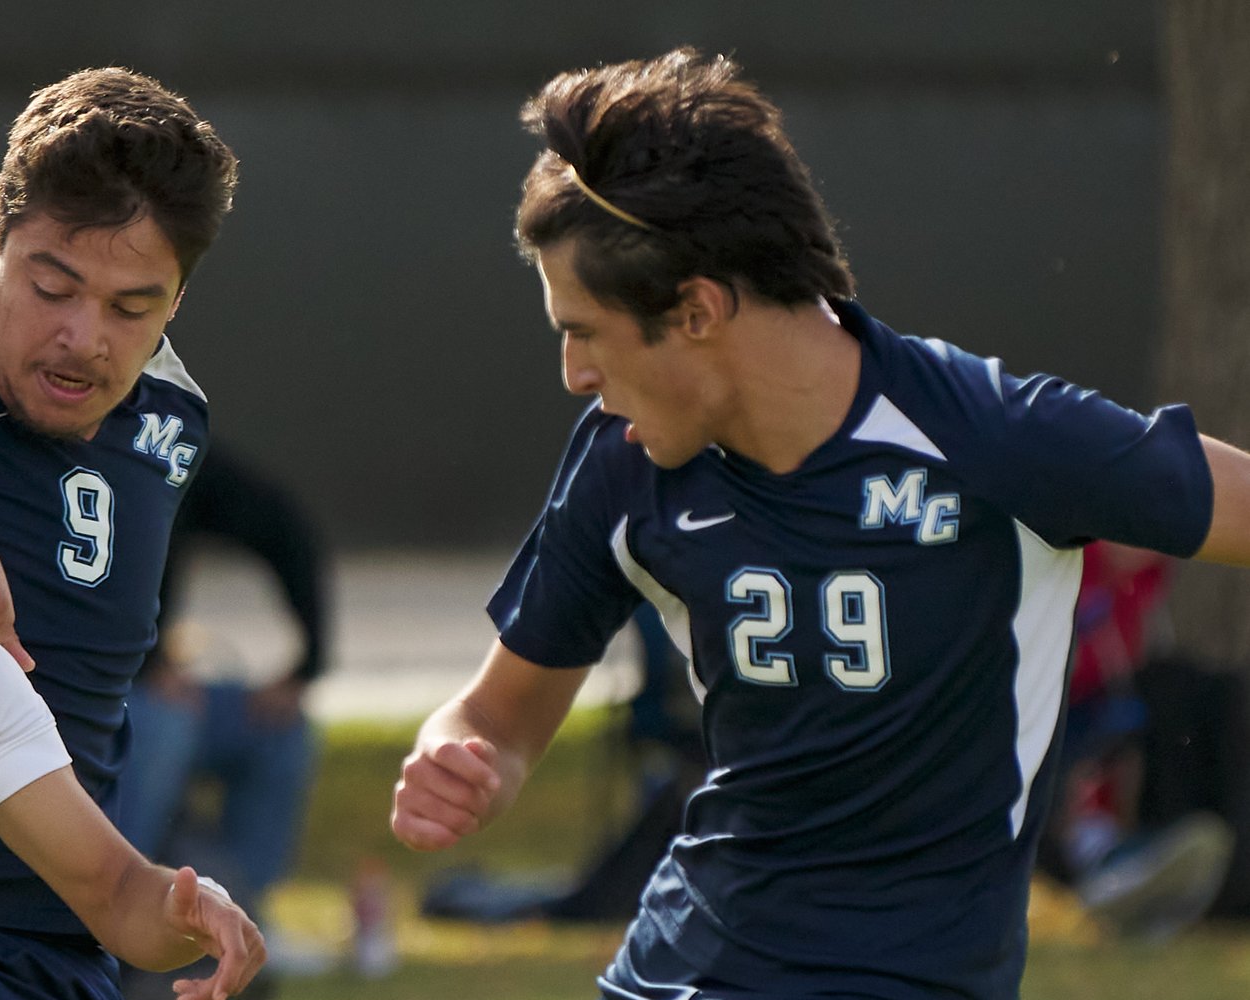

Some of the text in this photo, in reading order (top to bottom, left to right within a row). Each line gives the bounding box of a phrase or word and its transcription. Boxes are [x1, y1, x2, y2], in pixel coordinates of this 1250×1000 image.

[133, 412, 199, 488] MC
[57, 466, 115, 588] 9
[860, 467, 960, 546] MC
[725, 566, 892, 692] 29
